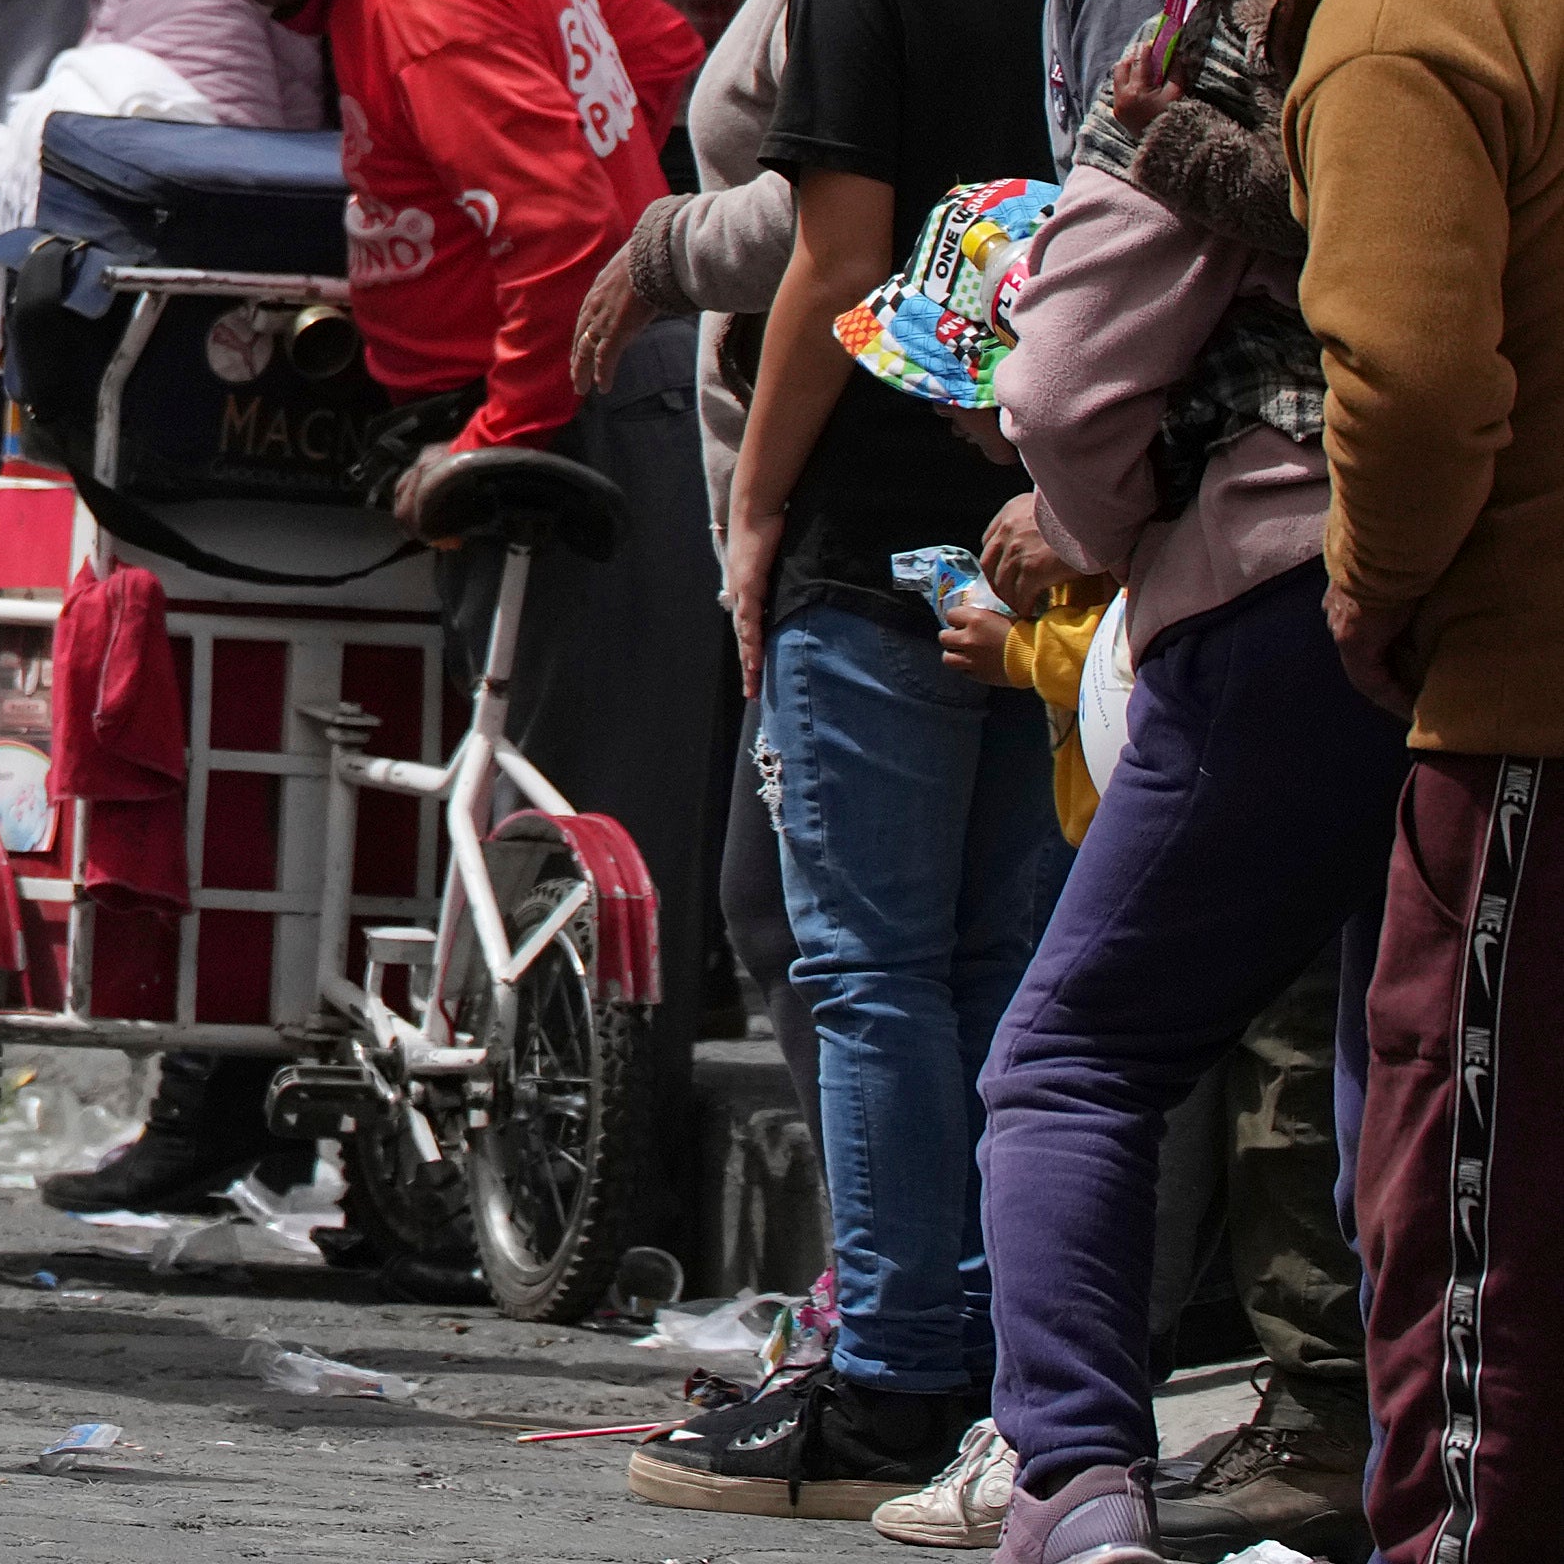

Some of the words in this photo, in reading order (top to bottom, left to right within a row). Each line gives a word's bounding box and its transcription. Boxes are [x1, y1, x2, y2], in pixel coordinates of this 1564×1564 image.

[968, 185, 999, 215] RACE
[935, 229, 960, 279] ONE
[1503, 765, 1532, 804] NIKE
[1476, 892, 1507, 934] NIKE
[1465, 1025, 1491, 1067] NIKE
[1458, 1156, 1483, 1196] NIKE
[1450, 1284, 1475, 1325] NIKE
